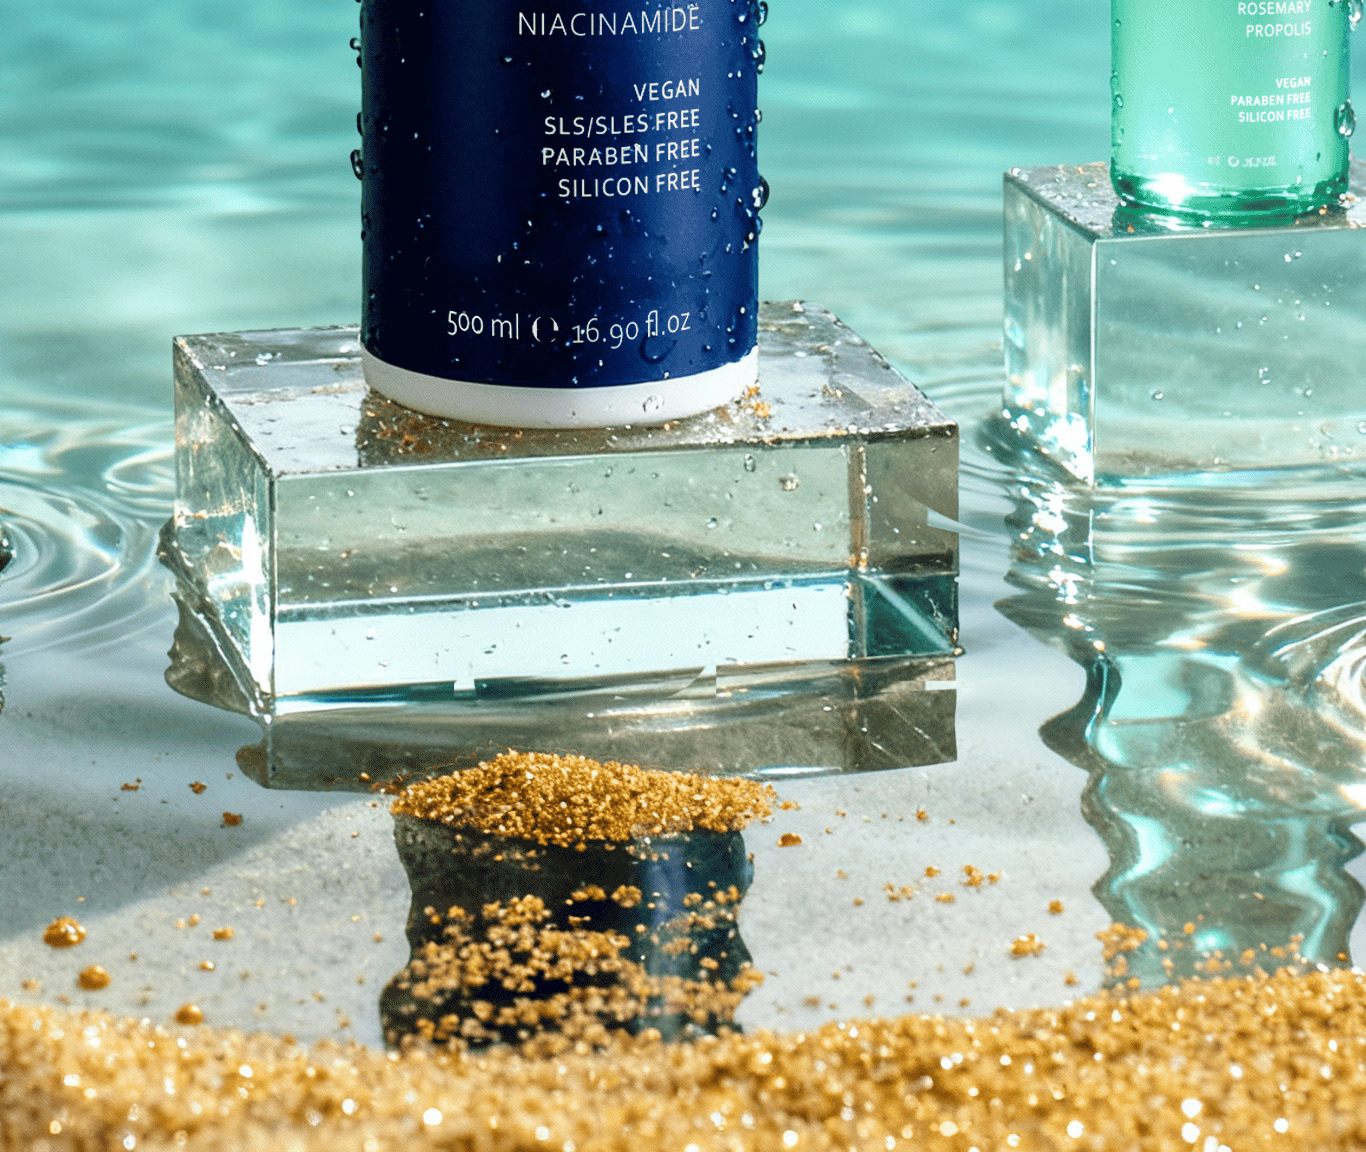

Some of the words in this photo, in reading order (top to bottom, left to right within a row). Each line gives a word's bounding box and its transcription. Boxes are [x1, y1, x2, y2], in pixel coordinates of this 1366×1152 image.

[1238, 0, 1312, 16] ROSEMARY
[518, 7, 700, 36] NIACINAMIDE
[1246, 22, 1312, 37] PROPOLIS
[634, 79, 700, 101] VEGAN
[1276, 76, 1312, 89] VEGAN
[1231, 94, 1285, 107] PARABEN
[1287, 92, 1312, 105] FREE
[544, 114, 648, 138] SLS/SLES
[656, 109, 700, 132] FREE
[1238, 111, 1285, 123] SILICON
[1287, 108, 1312, 121] FREE
[542, 144, 648, 166] PARABEN
[656, 139, 700, 162] FREE
[558, 175, 648, 198] SILICON
[656, 169, 700, 191] FREE
[447, 310, 484, 335] 500
[491, 313, 519, 340] ml
[572, 317, 639, 349] 16.90
